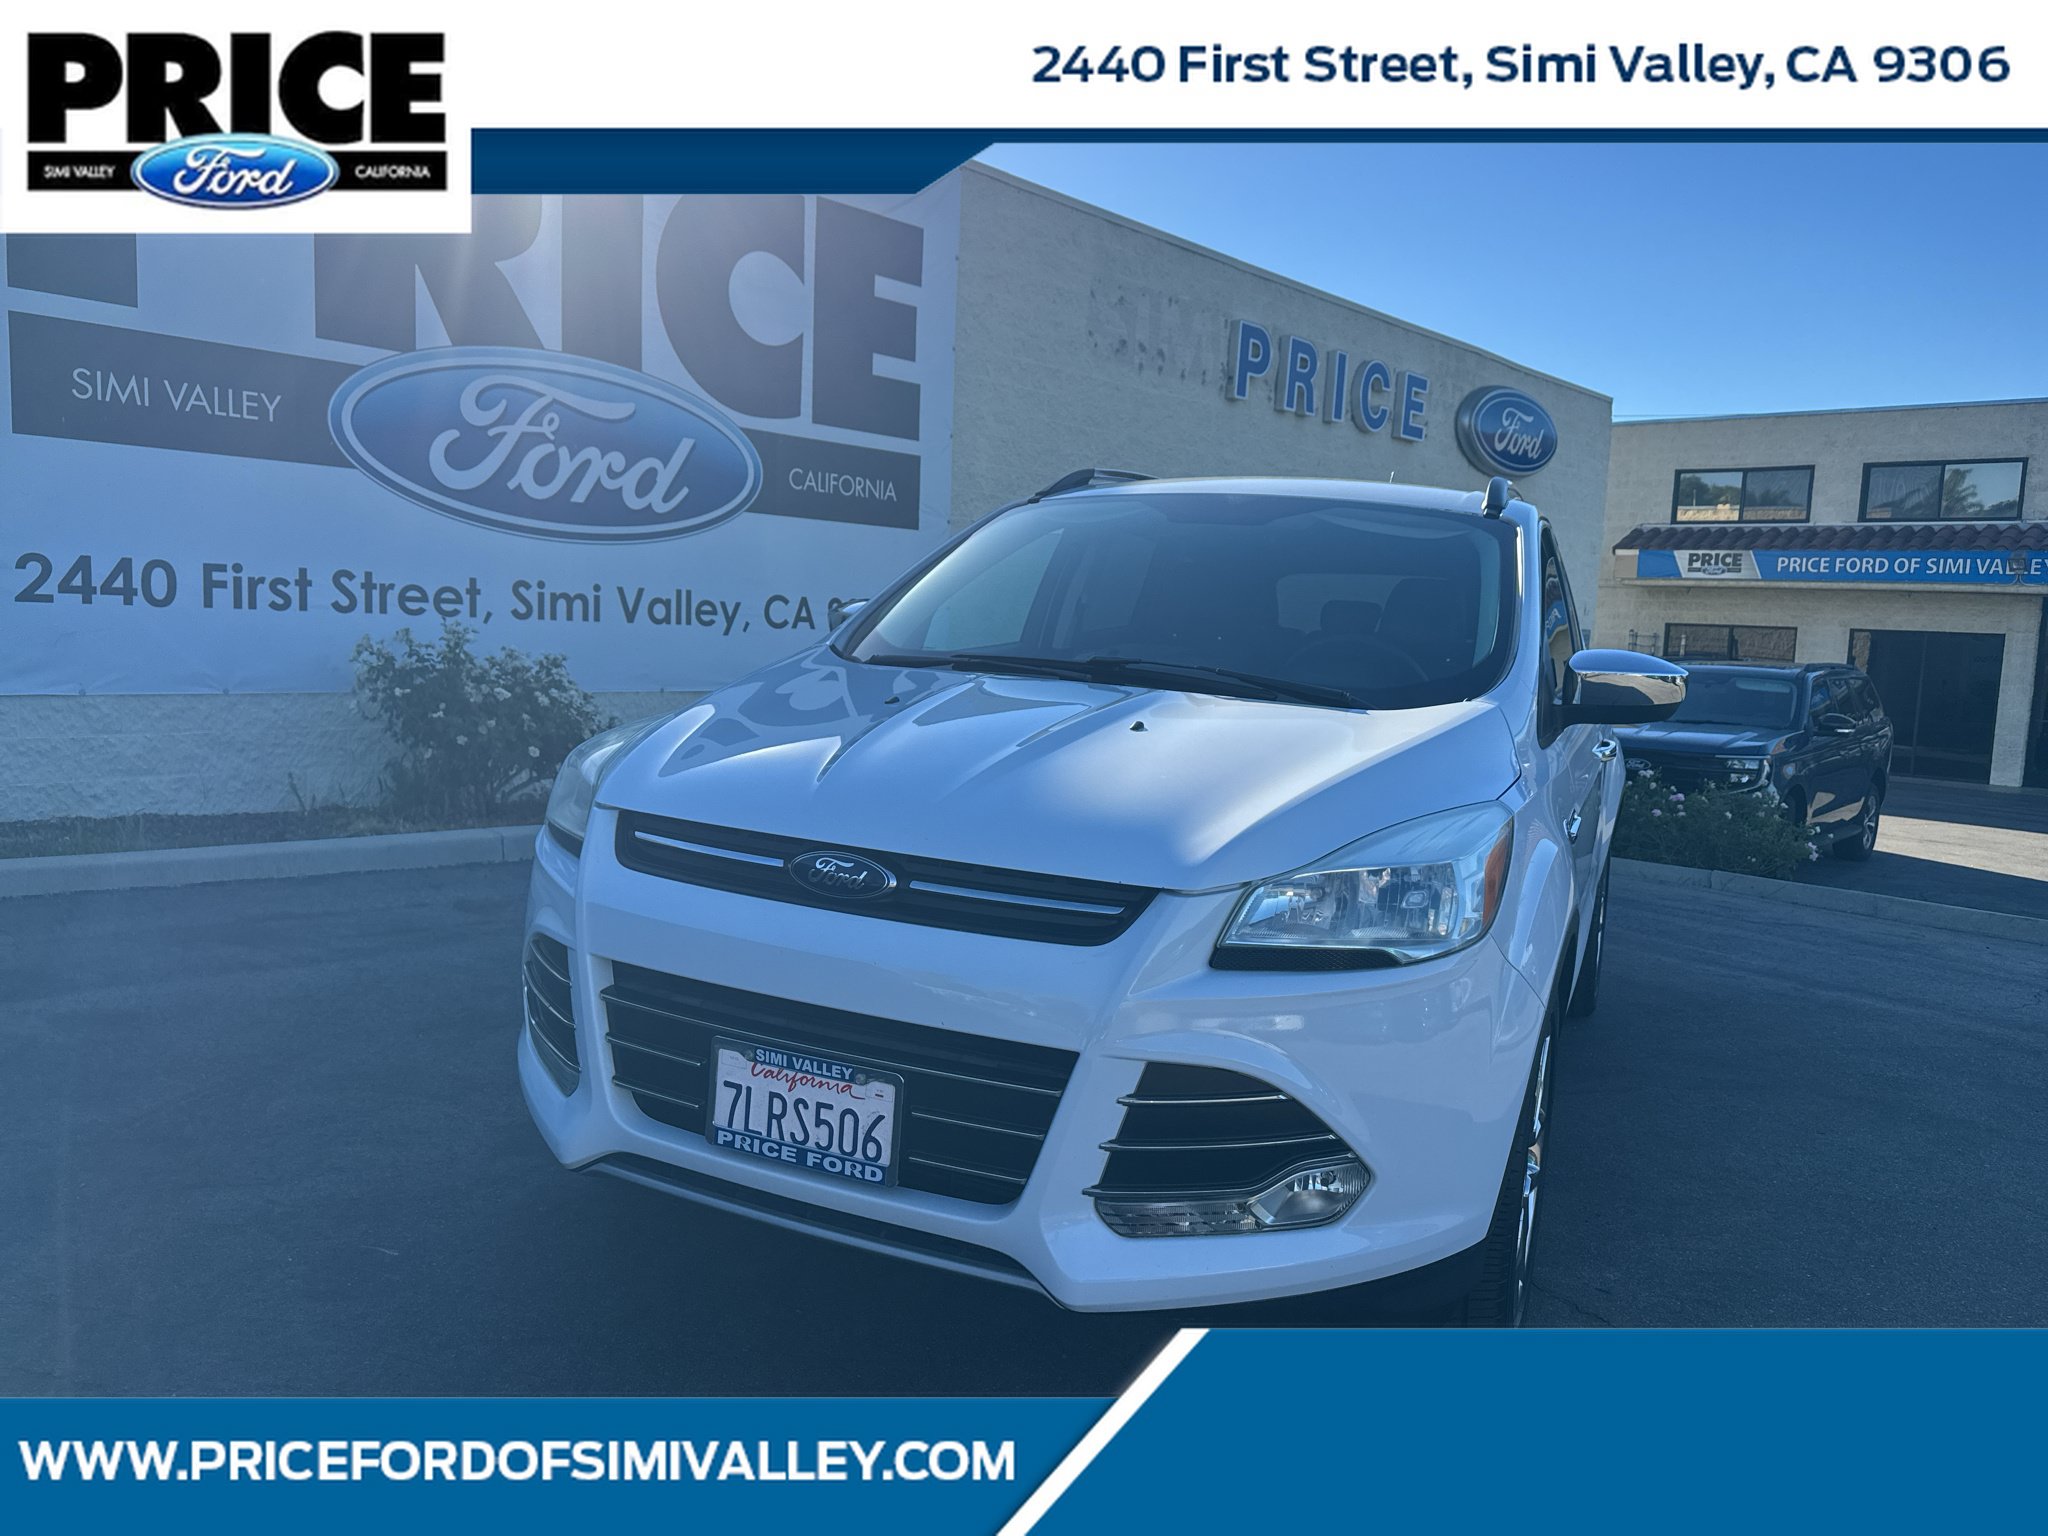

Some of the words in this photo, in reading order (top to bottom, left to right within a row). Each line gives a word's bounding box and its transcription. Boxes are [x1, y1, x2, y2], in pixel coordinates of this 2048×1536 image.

[7, 195, 924, 441] RICE
[71, 367, 150, 407] SIMI
[163, 380, 282, 423] VALLEY
[1231, 320, 1430, 442] PRICE
[428, 375, 696, 513] Ford
[1494, 406, 1543, 459] Ford
[788, 467, 897, 502] CALIFORNIA
[1688, 552, 1743, 567] PRICE
[1777, 556, 1831, 573] PRICE
[1835, 557, 1889, 574] FORD
[1893, 557, 1921, 574] OF
[1925, 558, 1971, 575] SIMI
[14, 552, 178, 607] 2440
[202, 562, 313, 612] First
[330, 569, 493, 624] Street,
[510, 579, 602, 623] Simi
[616, 586, 751, 636] Valley,
[763, 594, 816, 630] CA
[808, 857, 868, 890] Ford
[751, 1061, 866, 1100] California
[755, 1048, 787, 1067] SIMI
[792, 1056, 853, 1080] VALLEY
[723, 1080, 886, 1163] 7LRS506
[717, 1130, 797, 1163] PRICE
[806, 1154, 883, 1182] FORD
